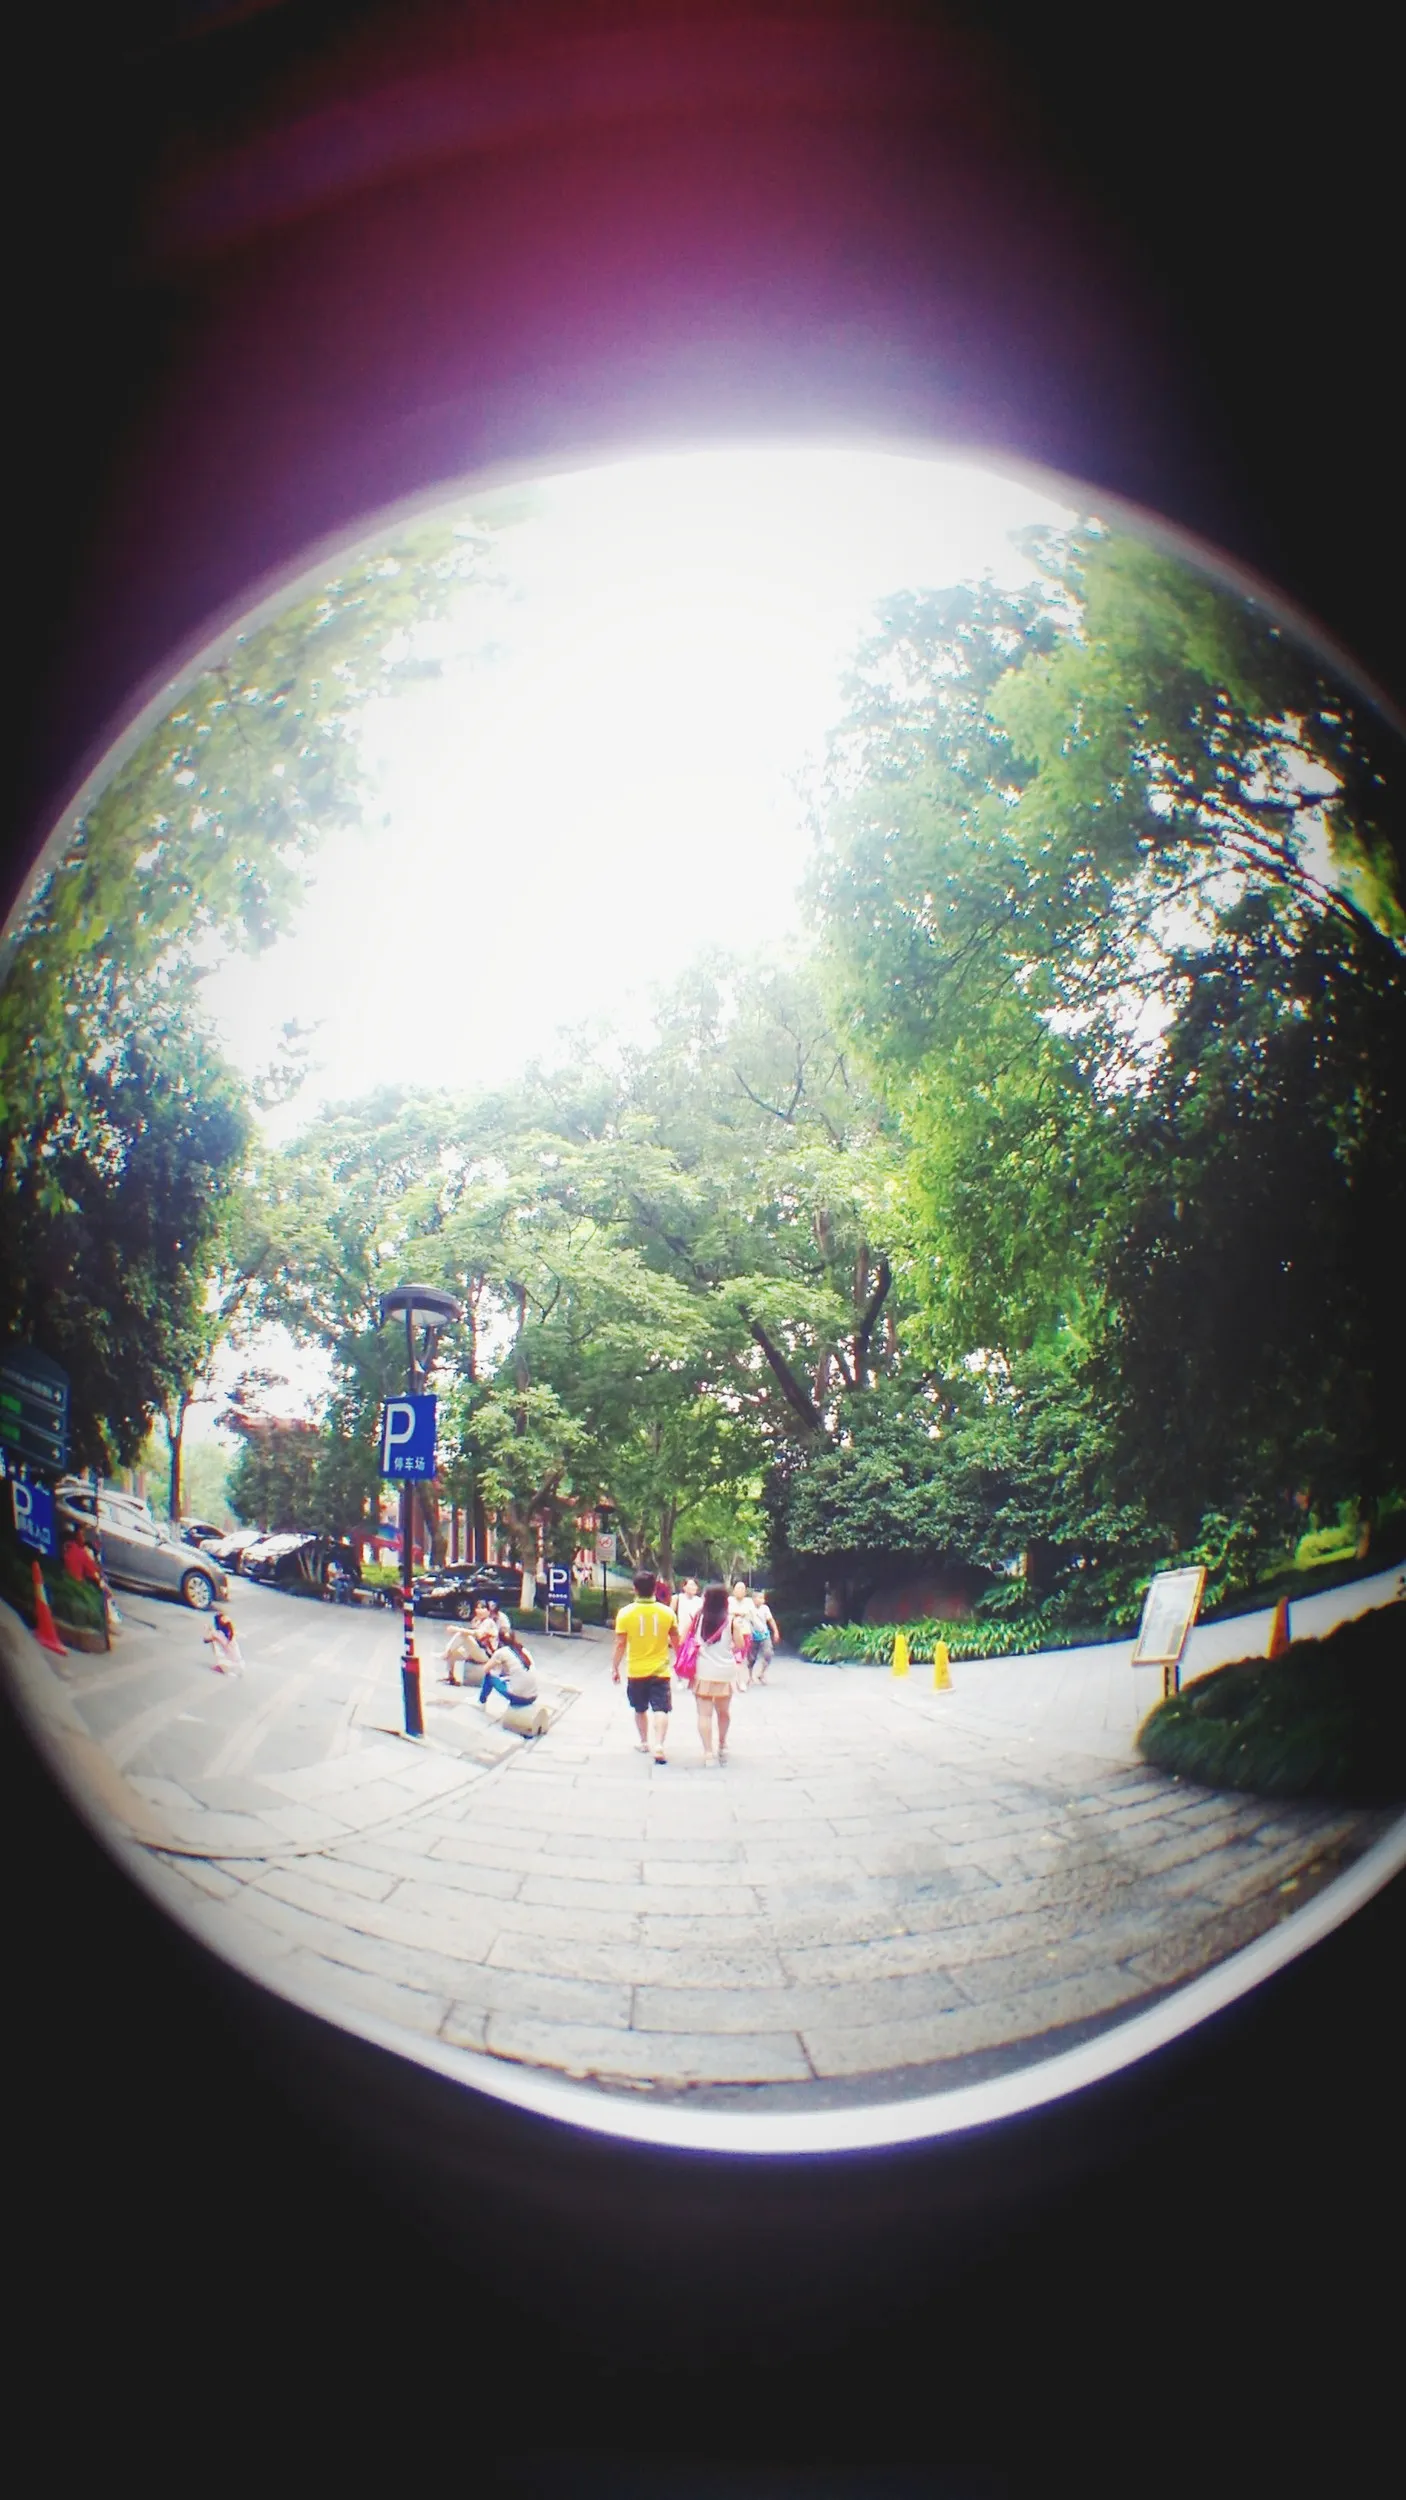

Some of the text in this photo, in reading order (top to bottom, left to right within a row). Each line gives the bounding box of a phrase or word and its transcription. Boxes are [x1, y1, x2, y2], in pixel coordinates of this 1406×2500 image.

[383, 1402, 416, 1472] P
[394, 1456, 425, 1471] 停车场
[12, 1480, 33, 1530] P
[549, 1569, 568, 1591] P
[639, 1613, 658, 1637] 11
